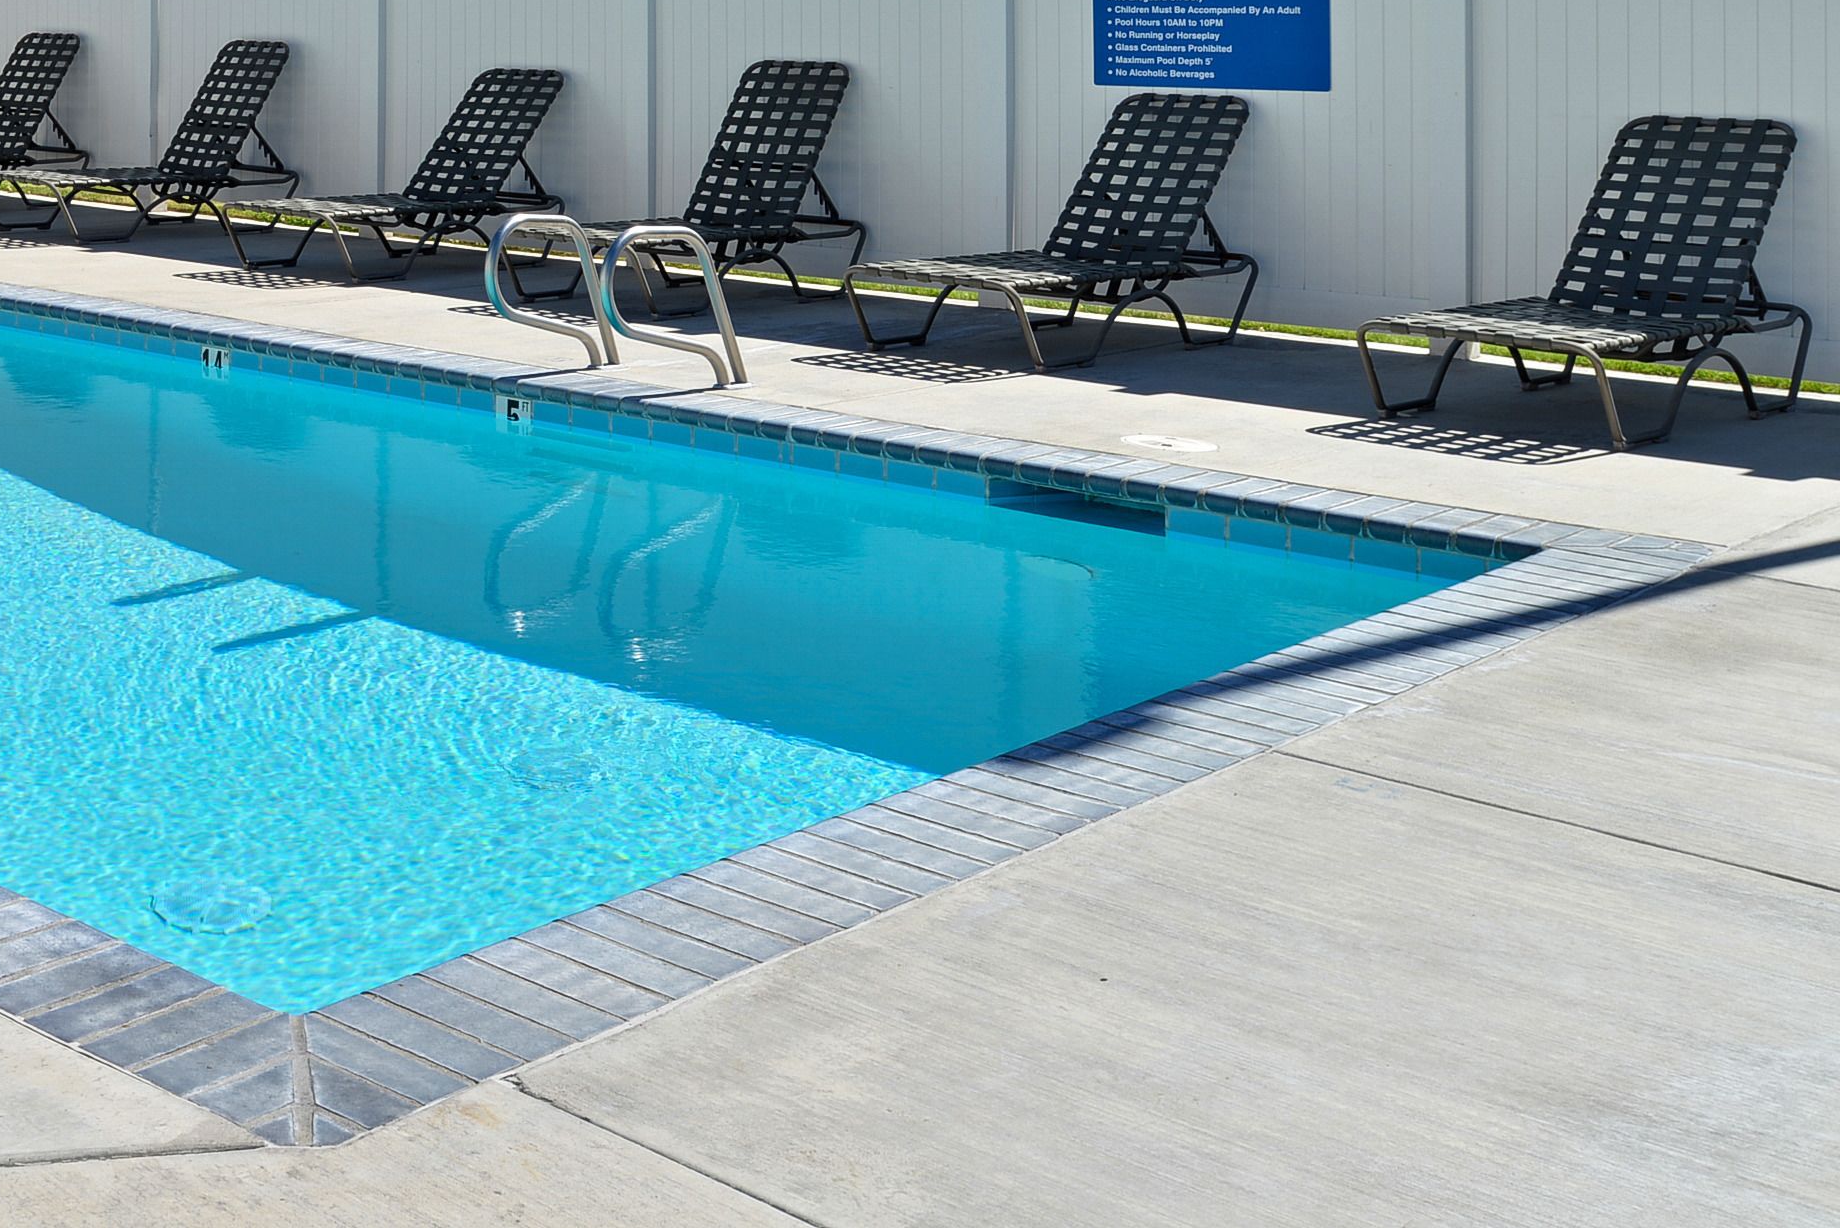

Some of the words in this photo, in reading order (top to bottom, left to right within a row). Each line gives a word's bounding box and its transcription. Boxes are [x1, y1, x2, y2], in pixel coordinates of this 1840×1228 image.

[1114, 5, 1149, 14] Children
[1151, 5, 1172, 14] Must
[1174, 6, 1185, 14] Be
[1187, 6, 1246, 16] Accompanied
[1248, 6, 1260, 16] By
[1262, 6, 1275, 14] An
[1277, 6, 1301, 14] Adult
[1114, 18, 1133, 26] Pool
[1135, 18, 1160, 26] Hours
[1163, 19, 1186, 27] 10AM
[1188, 19, 1197, 27] to
[1200, 19, 1224, 27] 10PM
[1114, 31, 1127, 39] No
[1129, 31, 1163, 41] Running
[1176, 32, 1220, 41] Horseplay
[1115, 43, 1138, 51] Glass
[1140, 44, 1186, 52] Containers
[1188, 44, 1232, 53] Prohibited
[1115, 56, 1155, 64] Maximum
[1156, 56, 1176, 64] Pool
[1177, 57, 1203, 66] Depth
[1115, 68, 1127, 76] No
[1129, 69, 1168, 77] Alcoholic
[1169, 70, 1215, 80] Beverages
[507, 399, 520, 421] 5
